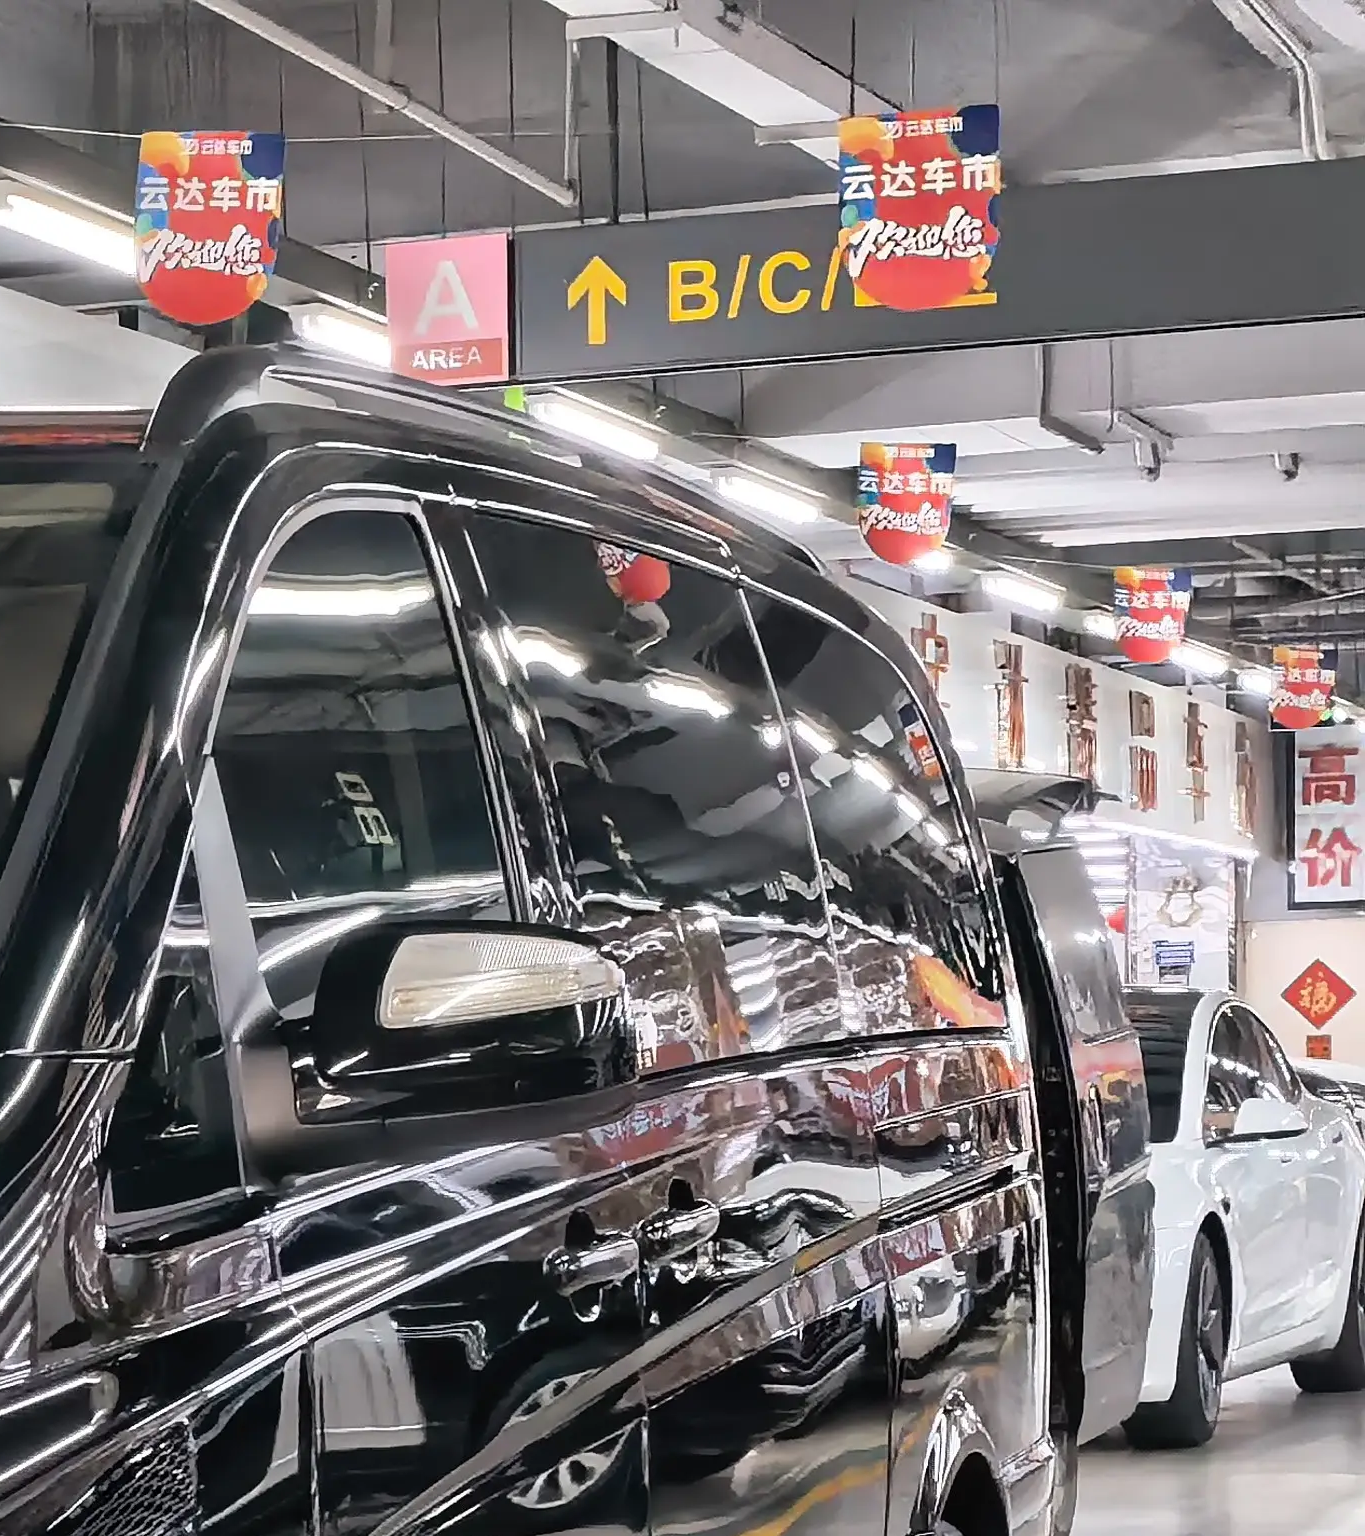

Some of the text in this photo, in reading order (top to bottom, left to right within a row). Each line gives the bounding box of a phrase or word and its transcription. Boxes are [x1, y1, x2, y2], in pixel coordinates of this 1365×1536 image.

[140, 177, 280, 213] 云达车市
[841, 154, 998, 200] 云达车市
[138, 224, 264, 283] 欢迎您
[849, 205, 985, 278] 欢迎您
[414, 259, 479, 337] A
[411, 345, 483, 371] AREA
[858, 469, 953, 495] 云达车市
[1297, 743, 1364, 888] 高价
